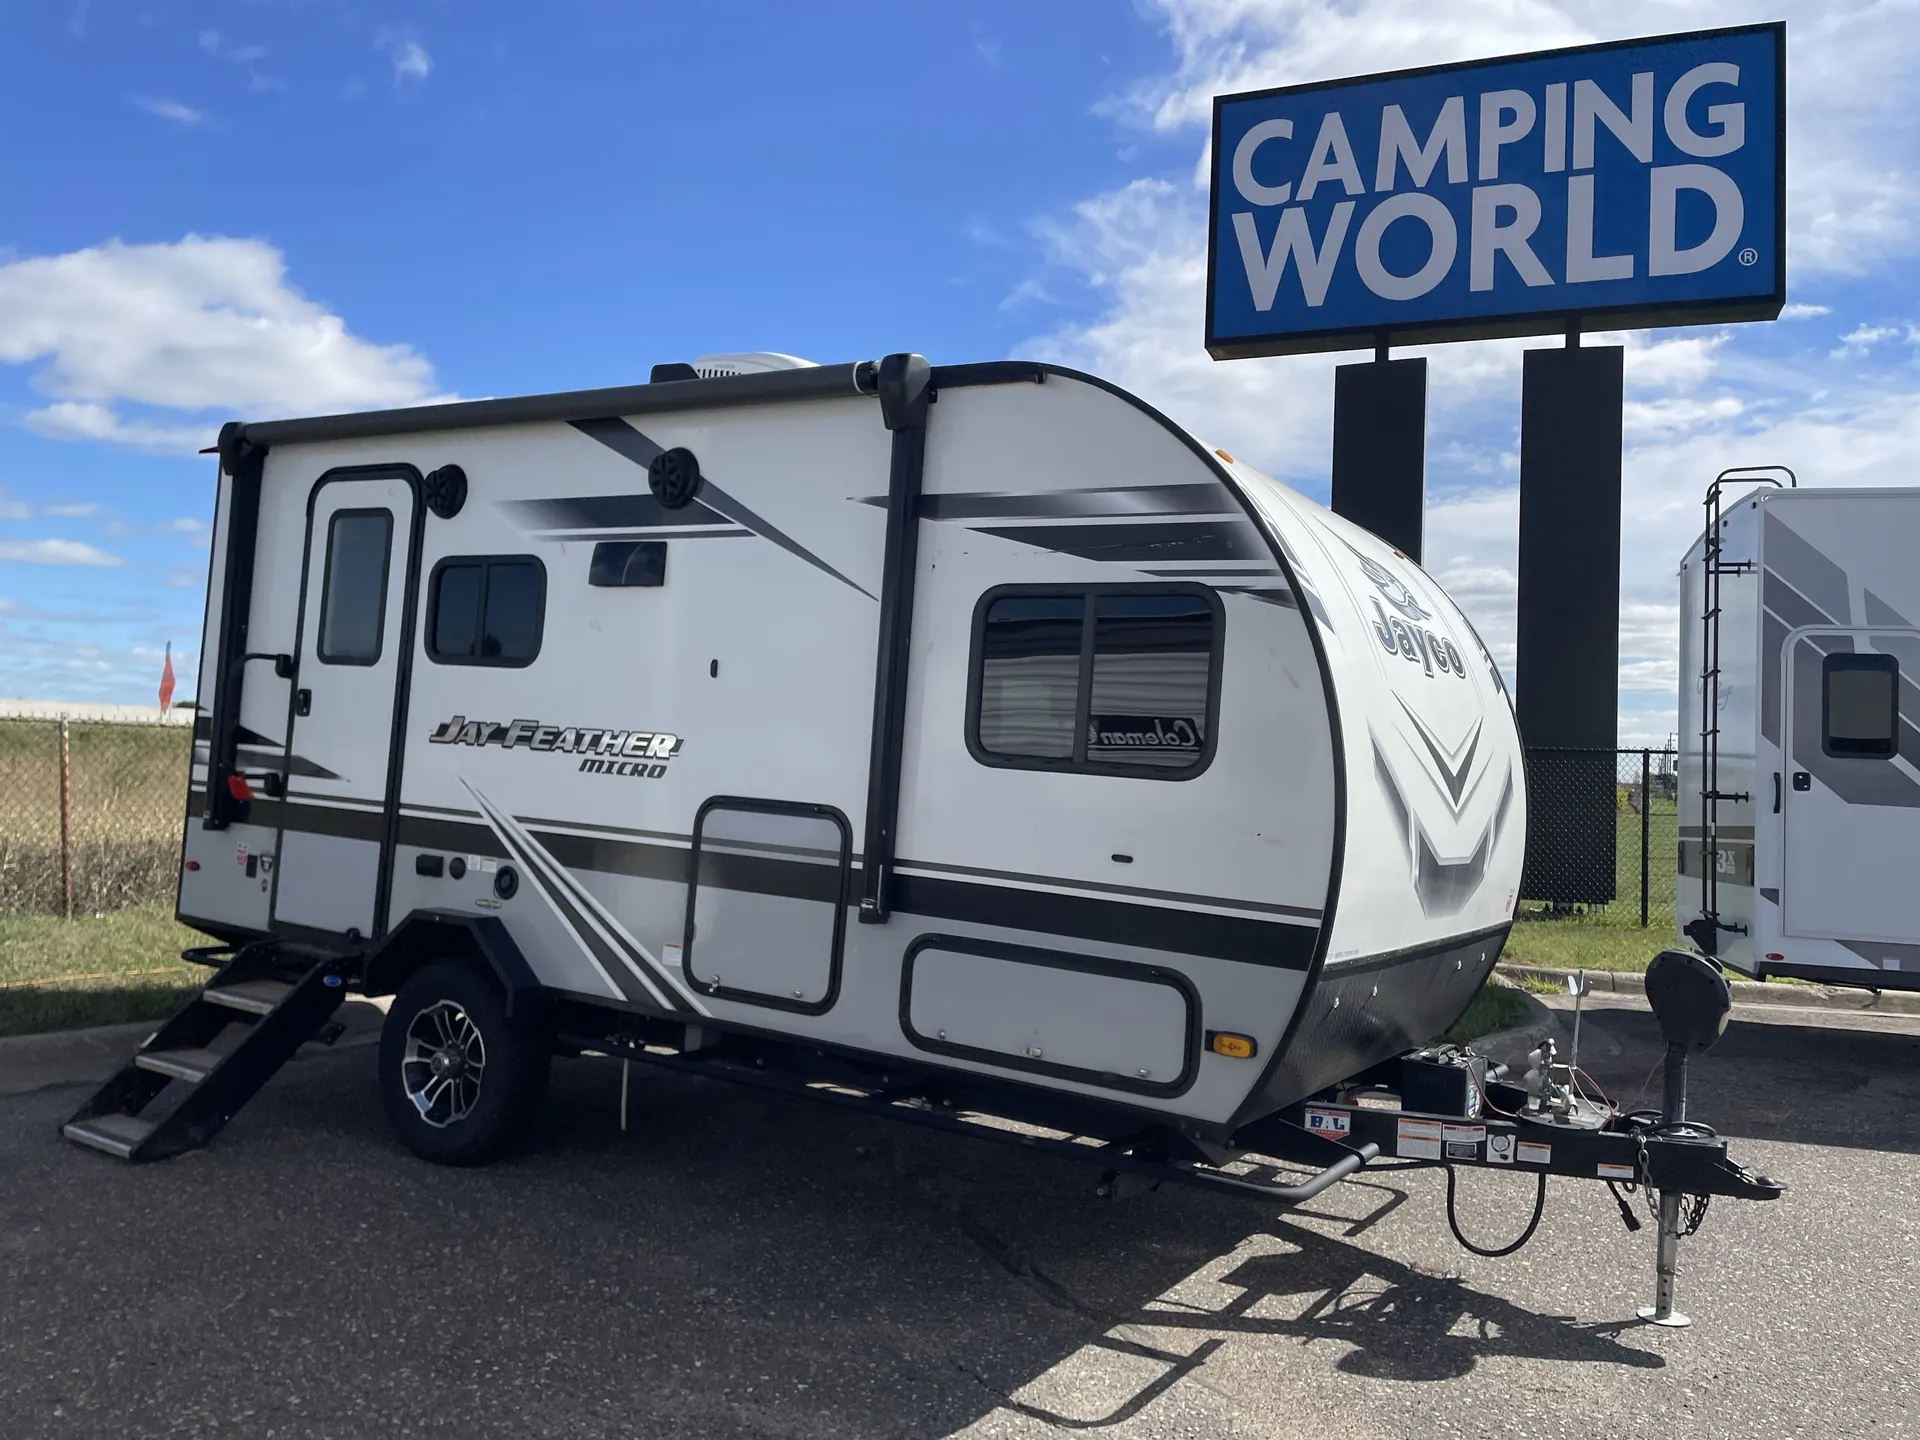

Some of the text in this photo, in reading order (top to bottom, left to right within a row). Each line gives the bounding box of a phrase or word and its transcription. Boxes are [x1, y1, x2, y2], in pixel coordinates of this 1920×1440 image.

[1232, 62, 1746, 207] CAMPING
[1231, 164, 1745, 311] WORLD
[1369, 594, 1466, 680] Jayco
[429, 715, 678, 760] JAY FEATHER
[579, 758, 668, 779] MICRO
